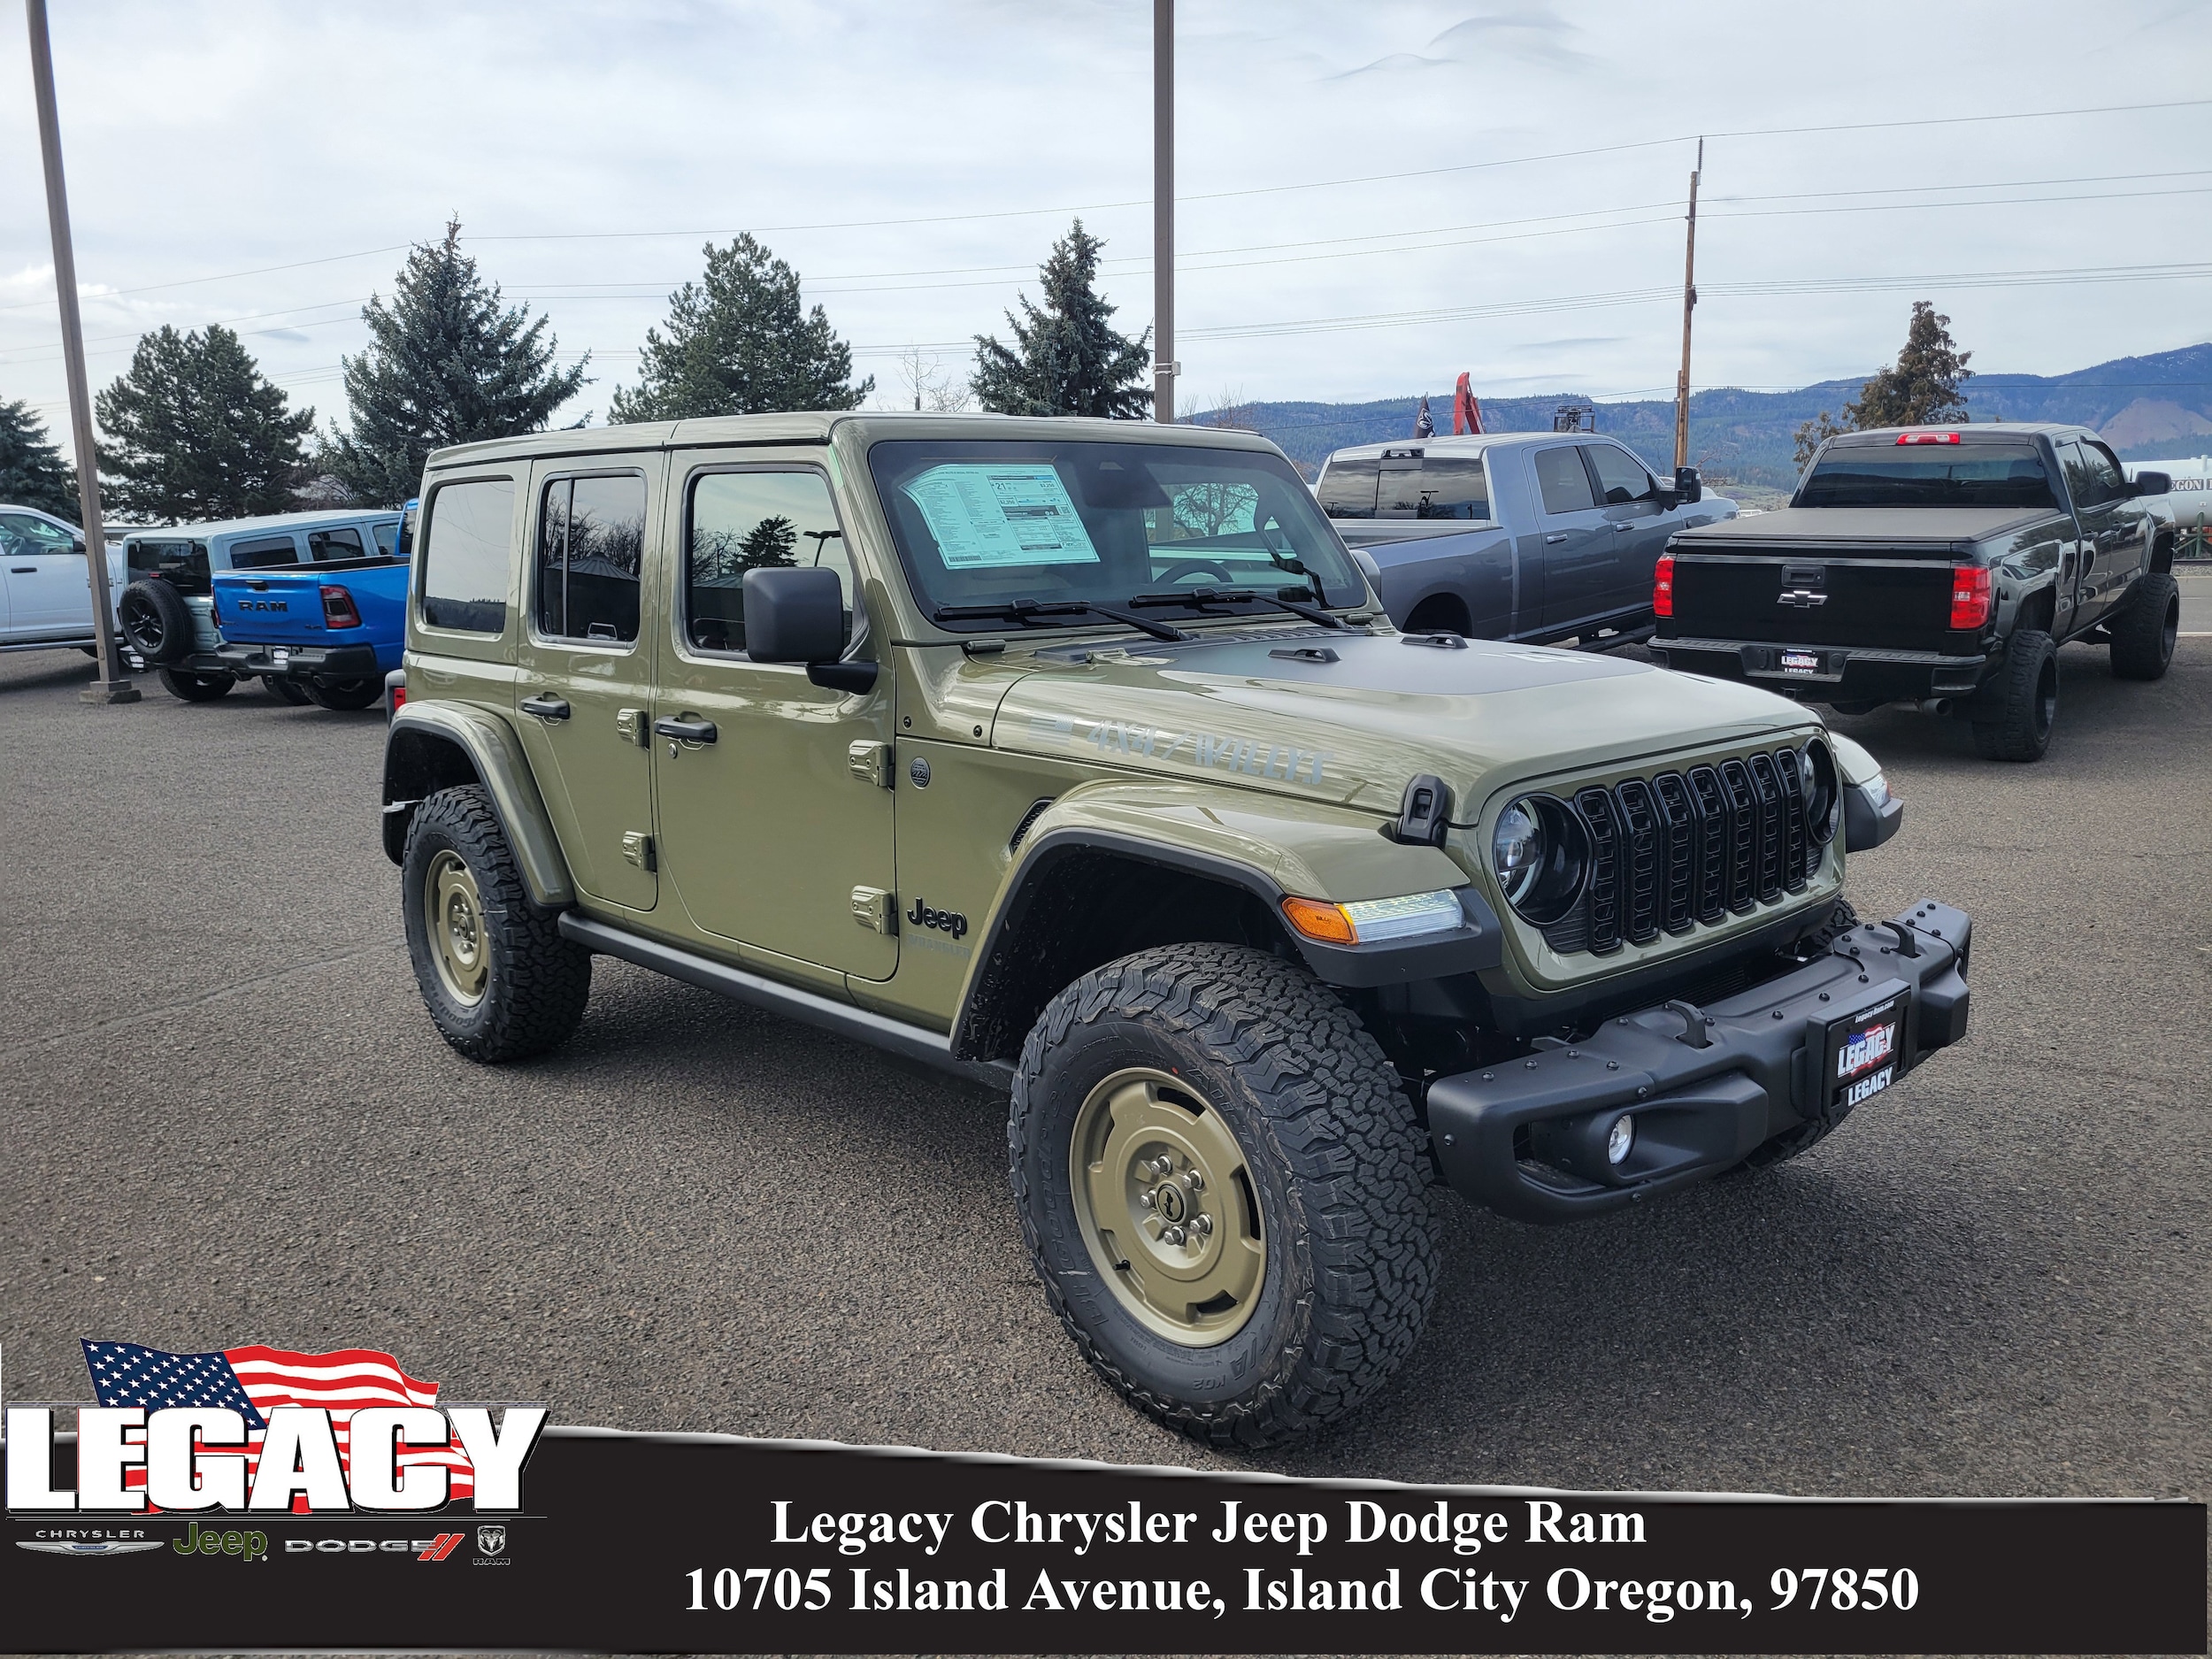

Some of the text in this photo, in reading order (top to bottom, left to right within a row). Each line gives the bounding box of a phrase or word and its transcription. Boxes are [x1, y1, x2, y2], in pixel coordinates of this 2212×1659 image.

[2171, 480, 2201, 491] EGON
[237, 600, 288, 612] RAM
[1781, 656, 1818, 666] LEGACY
[1195, 732, 1334, 785] WILLYS
[907, 896, 968, 940] Jeep
[1838, 1024, 1895, 1076] LEGACY
[1847, 1066, 1893, 1107] LEGACY
